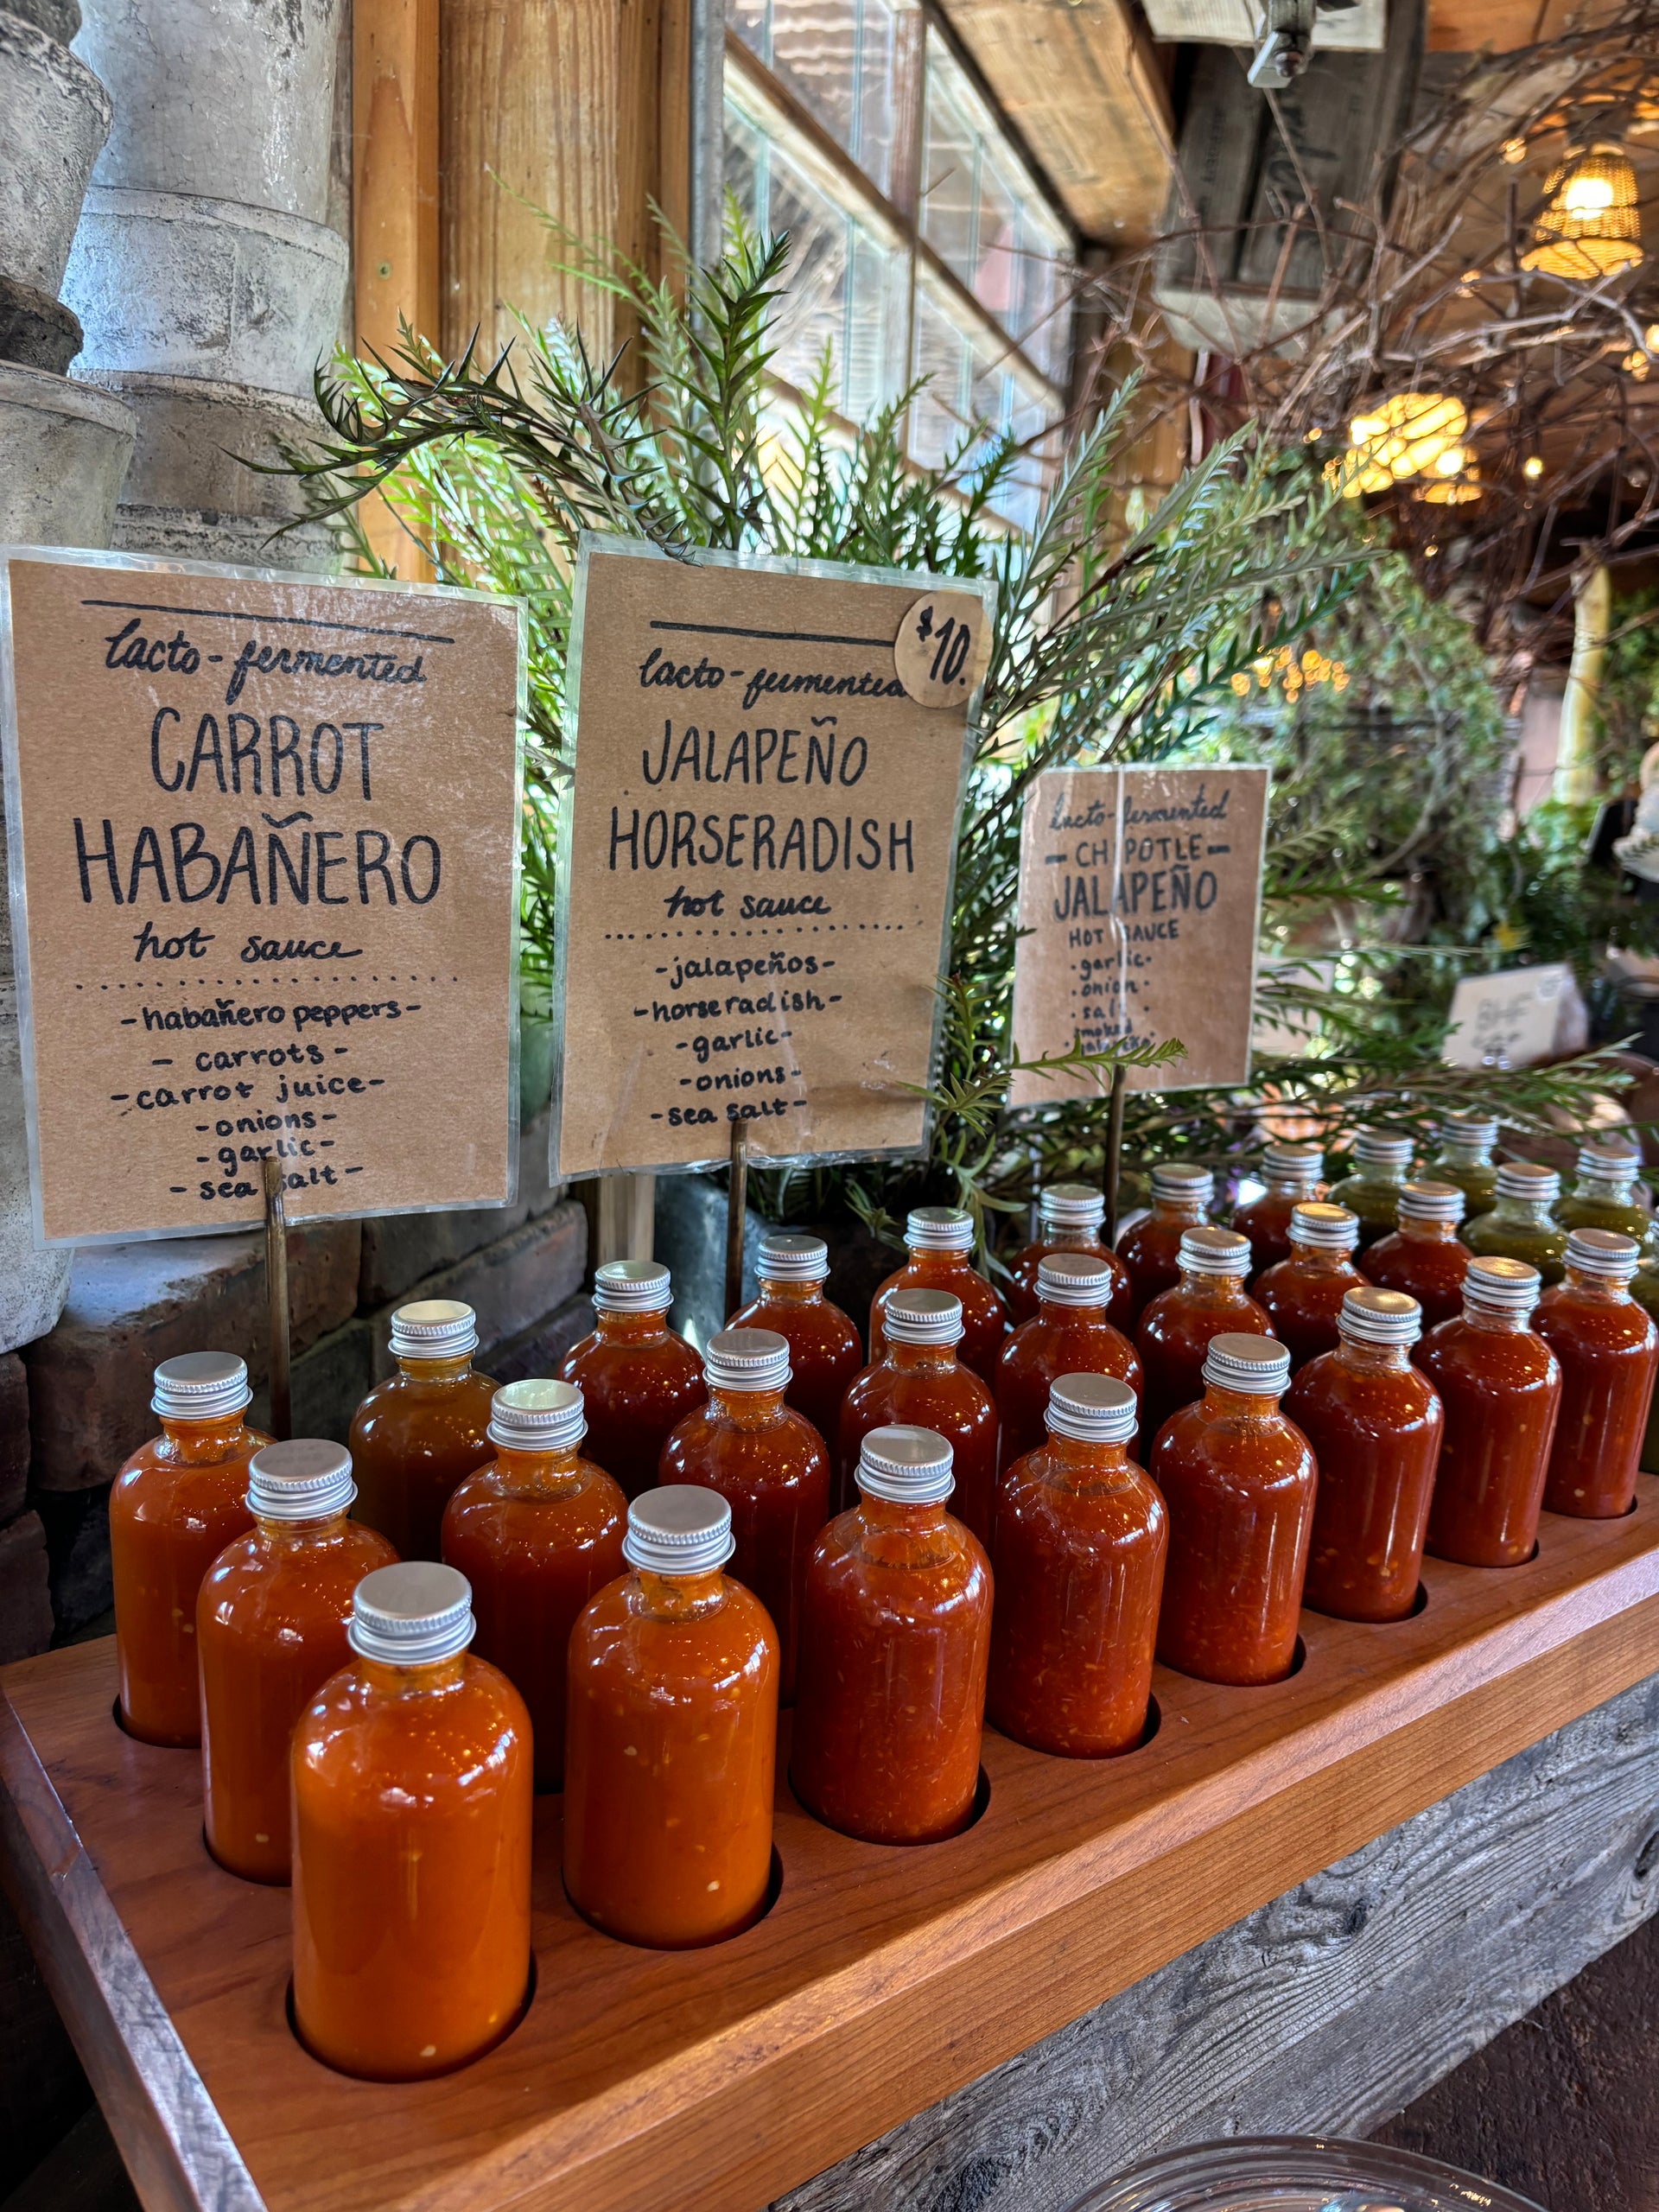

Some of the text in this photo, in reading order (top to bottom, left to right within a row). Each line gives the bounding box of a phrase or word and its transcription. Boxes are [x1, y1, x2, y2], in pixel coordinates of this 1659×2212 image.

[151, 707, 384, 800] CARROT
[643, 716, 868, 787] JALAPEÑO
[73, 811, 442, 905] HABAÑERO
[609, 805, 915, 874] HORSERADISH
[664, 885, 832, 920] hot sauce
[133, 922, 363, 963] hot sauce
[1069, 927, 1103, 948] HOT
